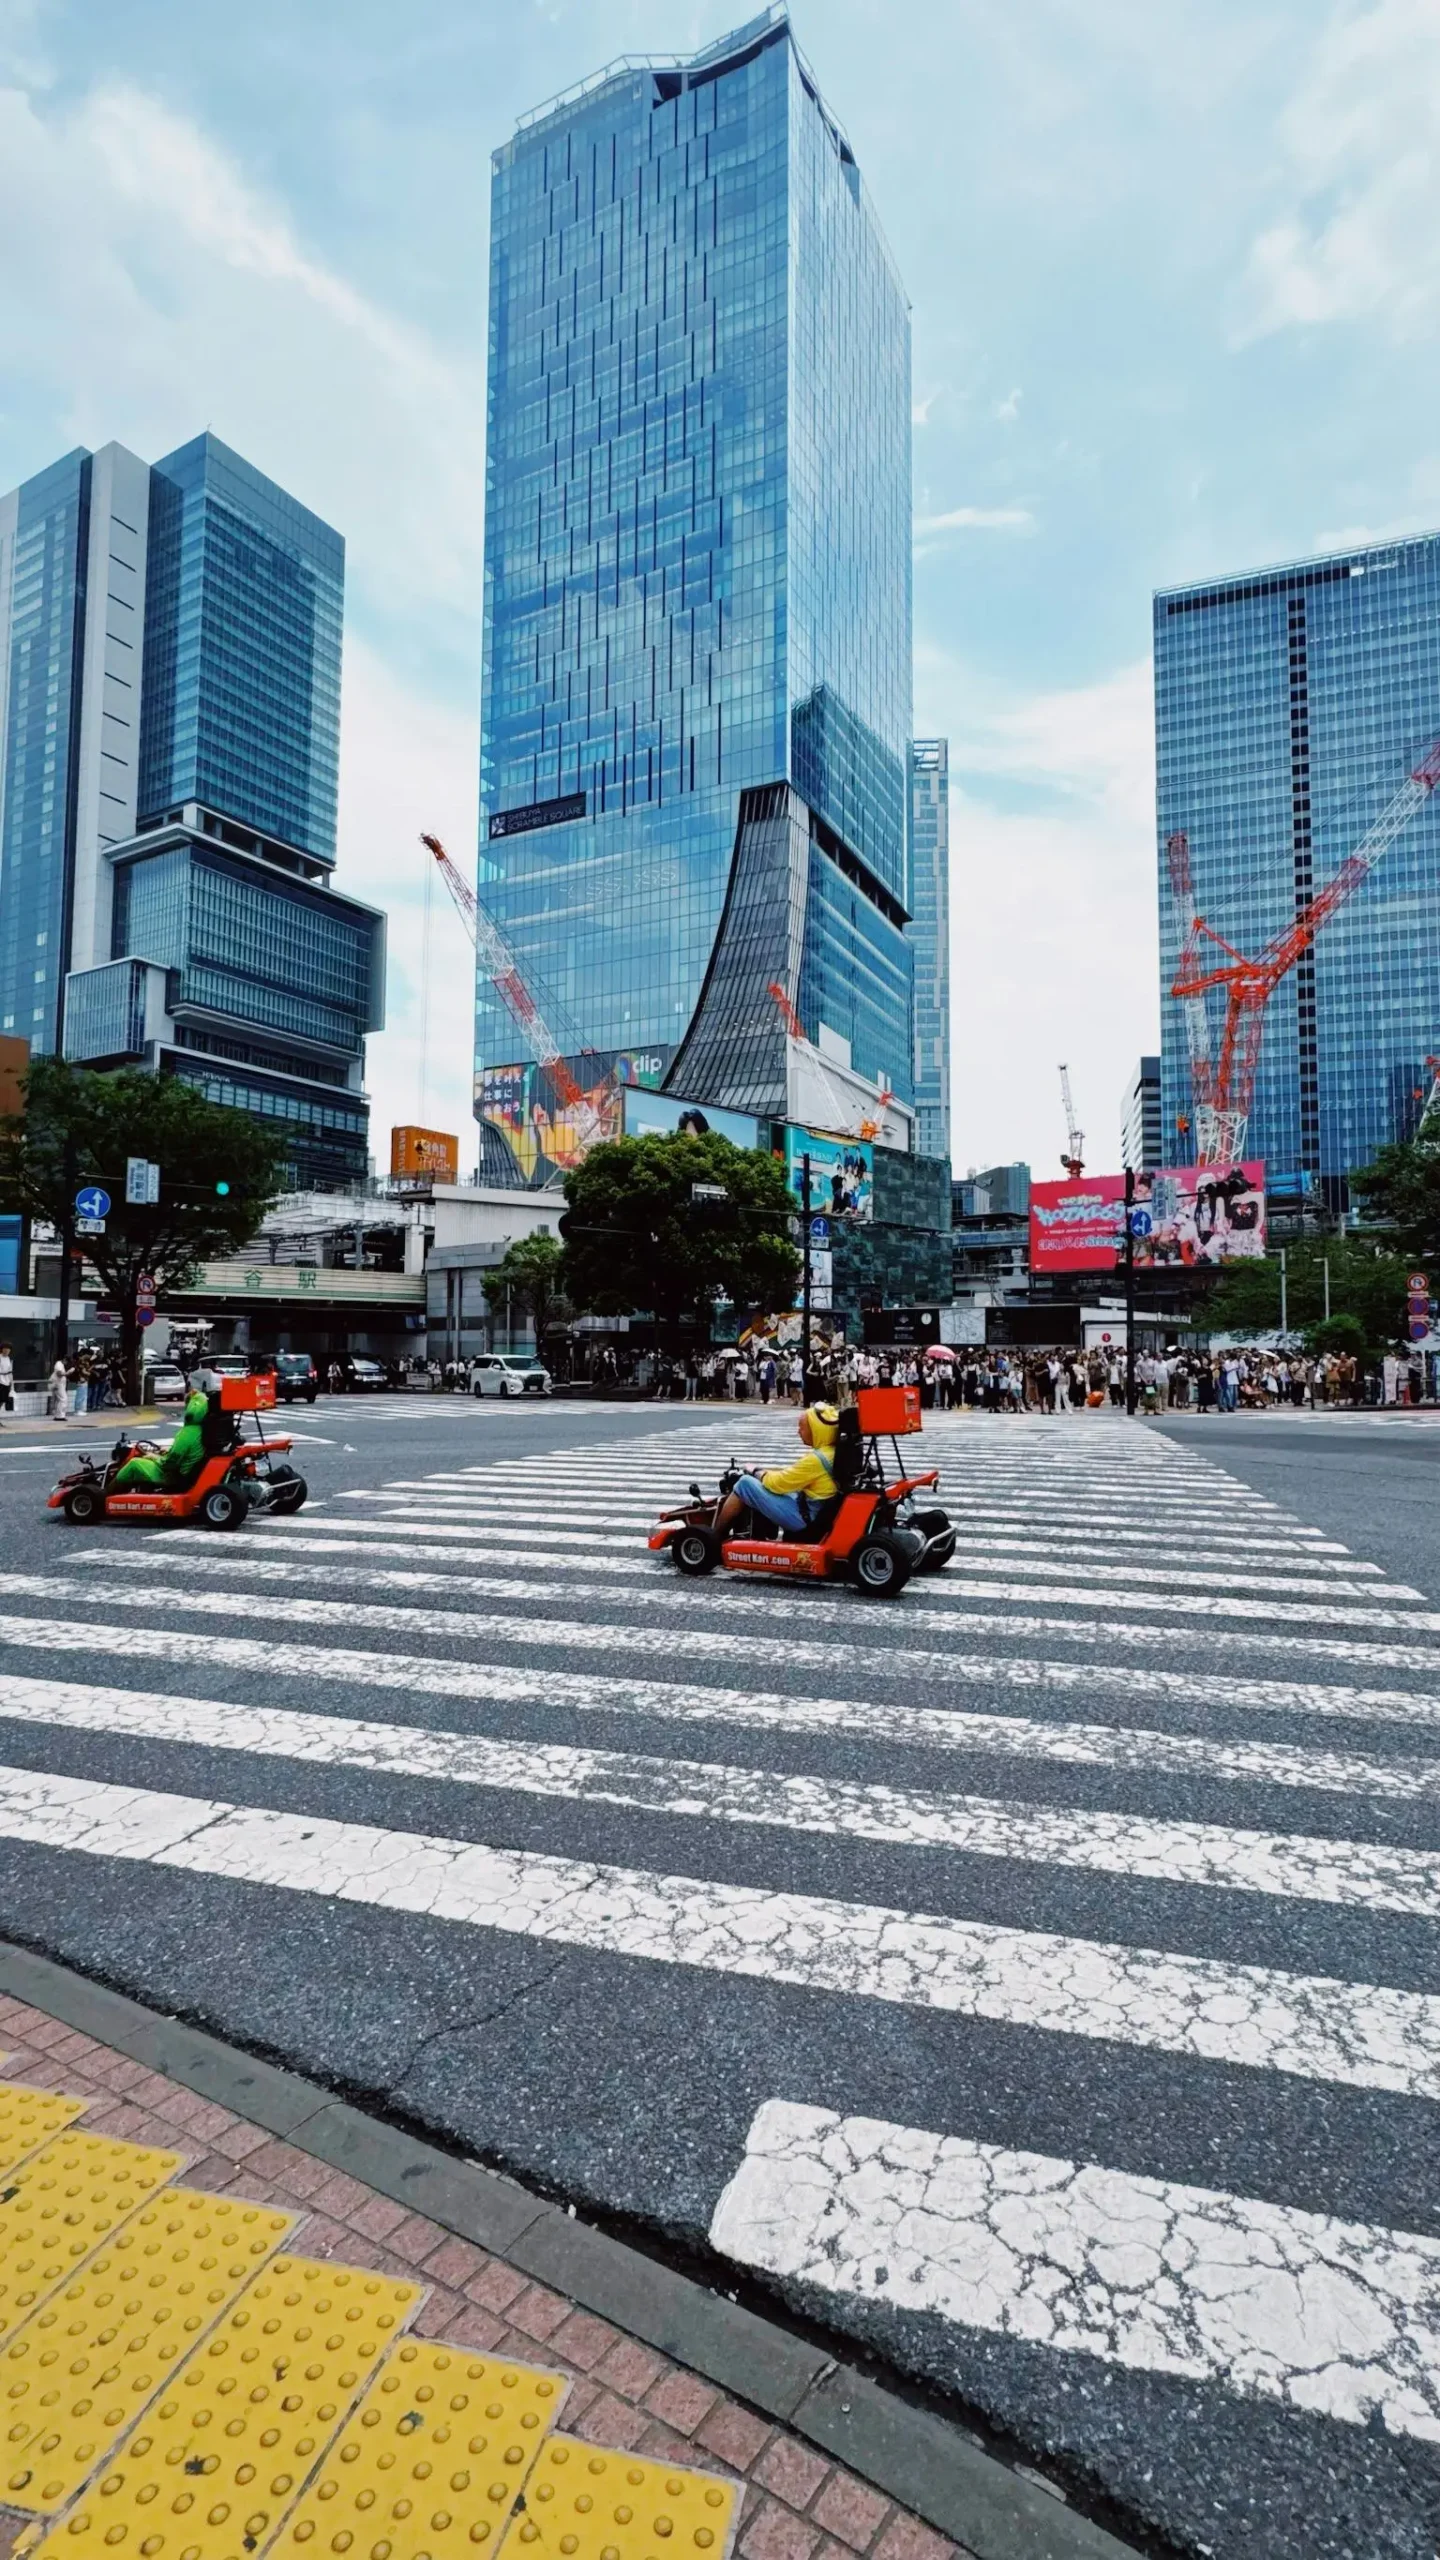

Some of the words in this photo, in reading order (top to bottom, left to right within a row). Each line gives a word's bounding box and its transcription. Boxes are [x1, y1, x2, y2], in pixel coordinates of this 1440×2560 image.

[507, 808, 541, 821] SHIBUYA
[507, 815, 548, 832] SCRAMBLE
[549, 806, 584, 821] SQUARE
[632, 1054, 662, 1075] dip
[484, 1088, 512, 1101] 仕事に
[727, 1551, 751, 1562] Street
[752, 1553, 770, 1564] Kart
[770, 1556, 790, 1565] .com
